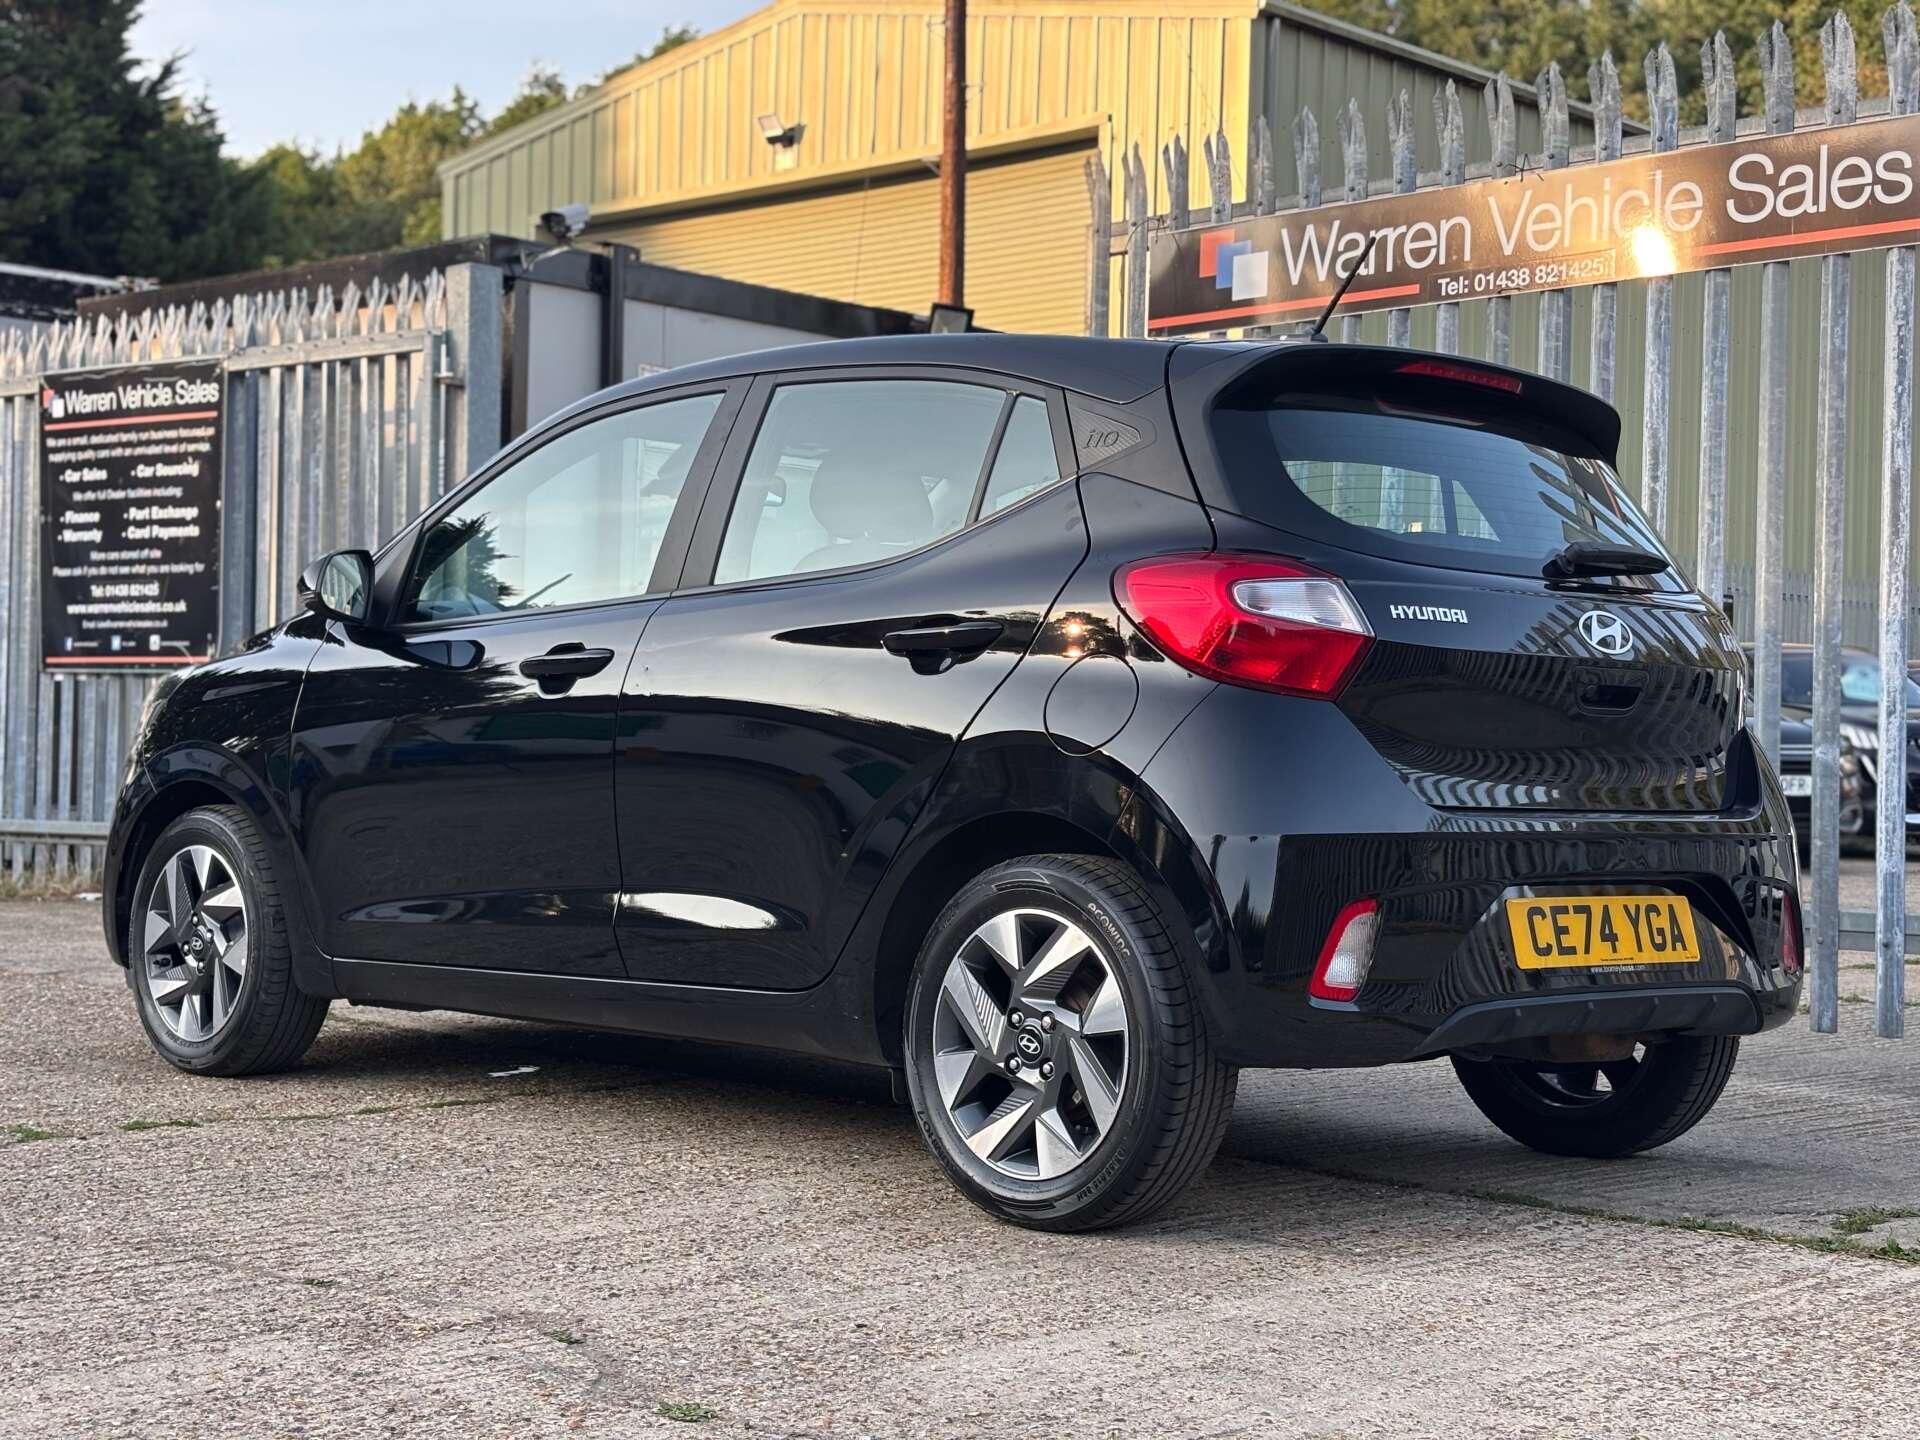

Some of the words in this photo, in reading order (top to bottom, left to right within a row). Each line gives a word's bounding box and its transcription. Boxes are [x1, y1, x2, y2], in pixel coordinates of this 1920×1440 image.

[1281, 215, 1472, 286] Warren
[1488, 169, 1704, 256] Vehicle
[1726, 144, 1913, 224] Sales
[1437, 275, 1469, 296] Tel:
[1474, 269, 1530, 292] 01438
[1534, 257, 1605, 284] 821425
[65, 388, 118, 415] Warren
[118, 382, 173, 411] Vehicle
[175, 378, 220, 405] Sales
[1082, 429, 1120, 449] i10
[64, 468, 81, 483] Car
[82, 467, 108, 482] Sales
[136, 464, 154, 478] Car
[65, 510, 100, 524] Finance
[129, 507, 150, 521] Part
[151, 505, 199, 521] Exchange
[62, 529, 103, 544] Warranty
[127, 525, 150, 540] Card
[152, 524, 200, 541] Payments
[1389, 604, 1469, 624] HYUNDAI
[1526, 904, 1619, 957] CE74
[1623, 903, 1688, 953] YGA
